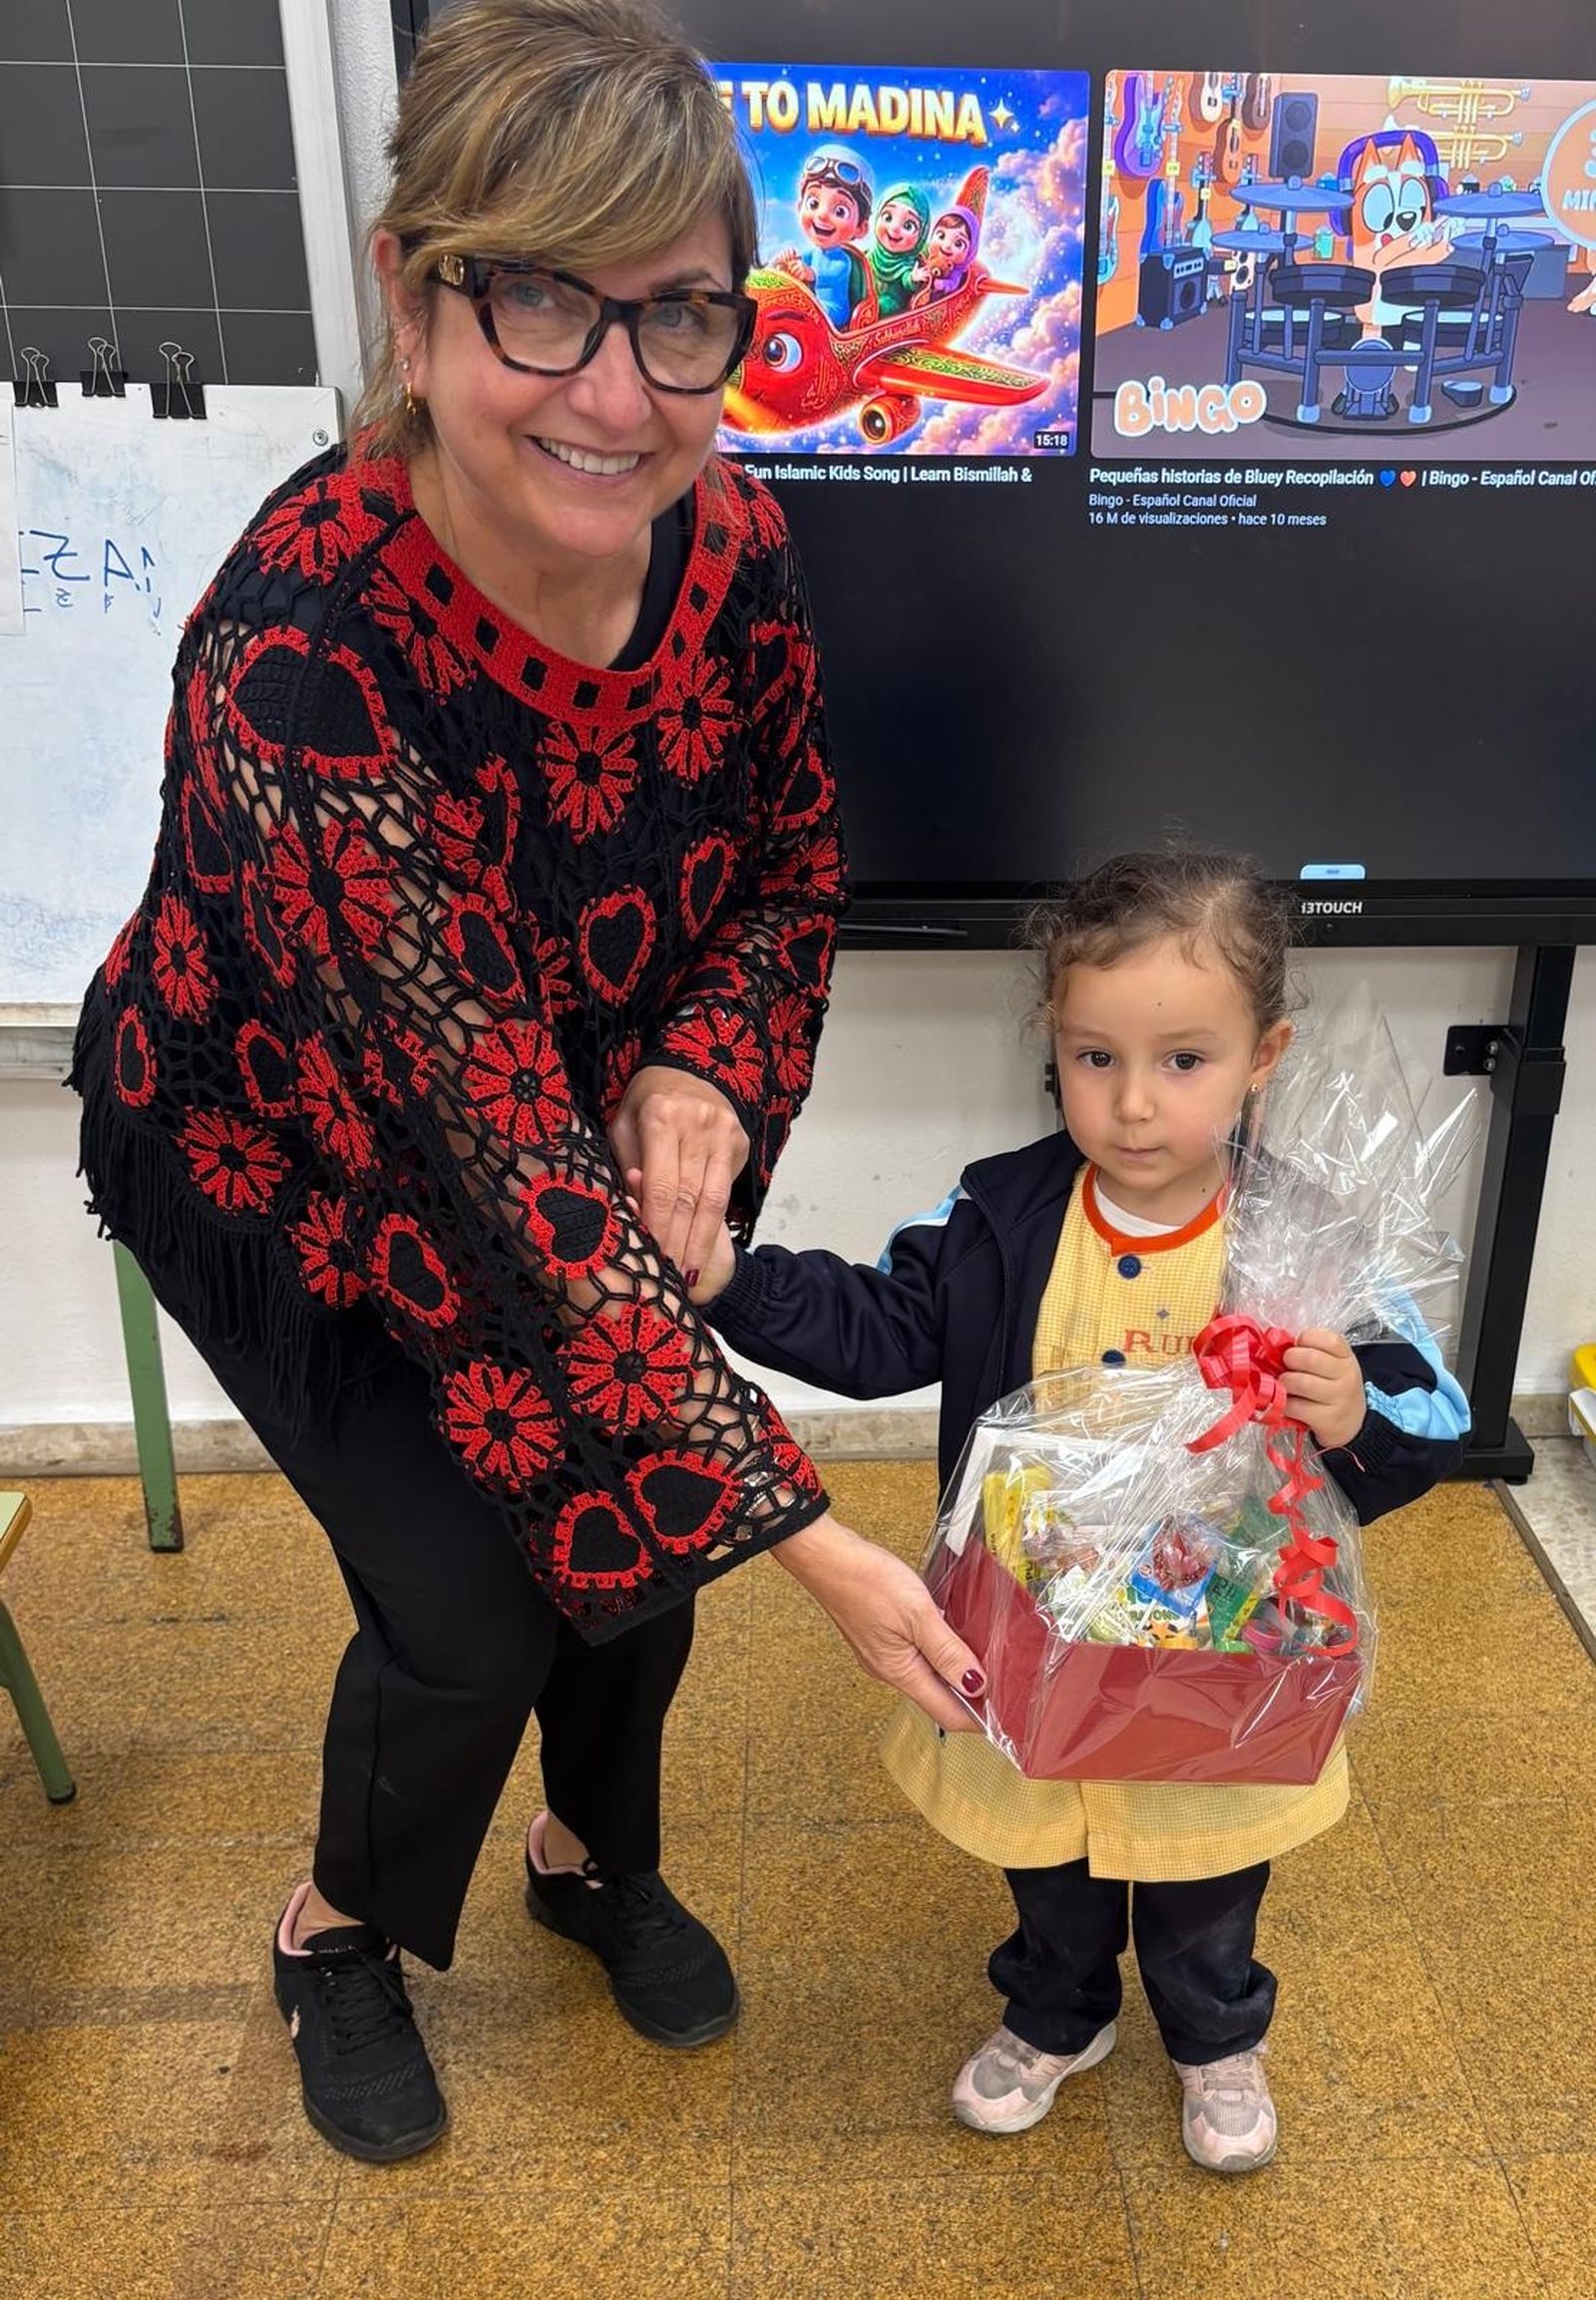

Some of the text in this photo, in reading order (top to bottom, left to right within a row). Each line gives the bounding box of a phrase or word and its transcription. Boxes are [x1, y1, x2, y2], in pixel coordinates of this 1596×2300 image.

[742, 80, 798, 132] TO
[806, 82, 989, 147] MADINA
[1035, 435, 1068, 447] 15:18
[744, 464, 772, 480] Fun
[774, 464, 827, 480] Islamic
[829, 465, 861, 481] Kids
[863, 466, 901, 484] Song
[911, 466, 951, 482] Learn
[954, 466, 1018, 482] Bismillah
[1020, 468, 1032, 483] &
[1089, 467, 1159, 486] Pequeñas
[1161, 467, 1222, 484] historias
[1224, 468, 1243, 484] de
[1245, 469, 1284, 487] Bluey
[1286, 469, 1375, 488] Recopilación
[1428, 470, 1469, 488] Bingo
[1480, 469, 1536, 488] Español
[1537, 469, 1578, 486] Canal
[1579, 469, 1596, 486] Of
[1088, 493, 1124, 509] Bingo
[1133, 493, 1181, 508] Español
[1183, 494, 1217, 507] Canal
[1219, 494, 1257, 507] Oficial
[1088, 512, 1104, 525] 16
[1106, 513, 1118, 525] M
[1120, 513, 1136, 525] de
[1138, 512, 1229, 525] visualizaciones
[1238, 513, 1268, 525] hace
[1270, 514, 1286, 526] 10
[1287, 516, 1328, 526] meses
[1301, 901, 1364, 915] i3TOUCH
